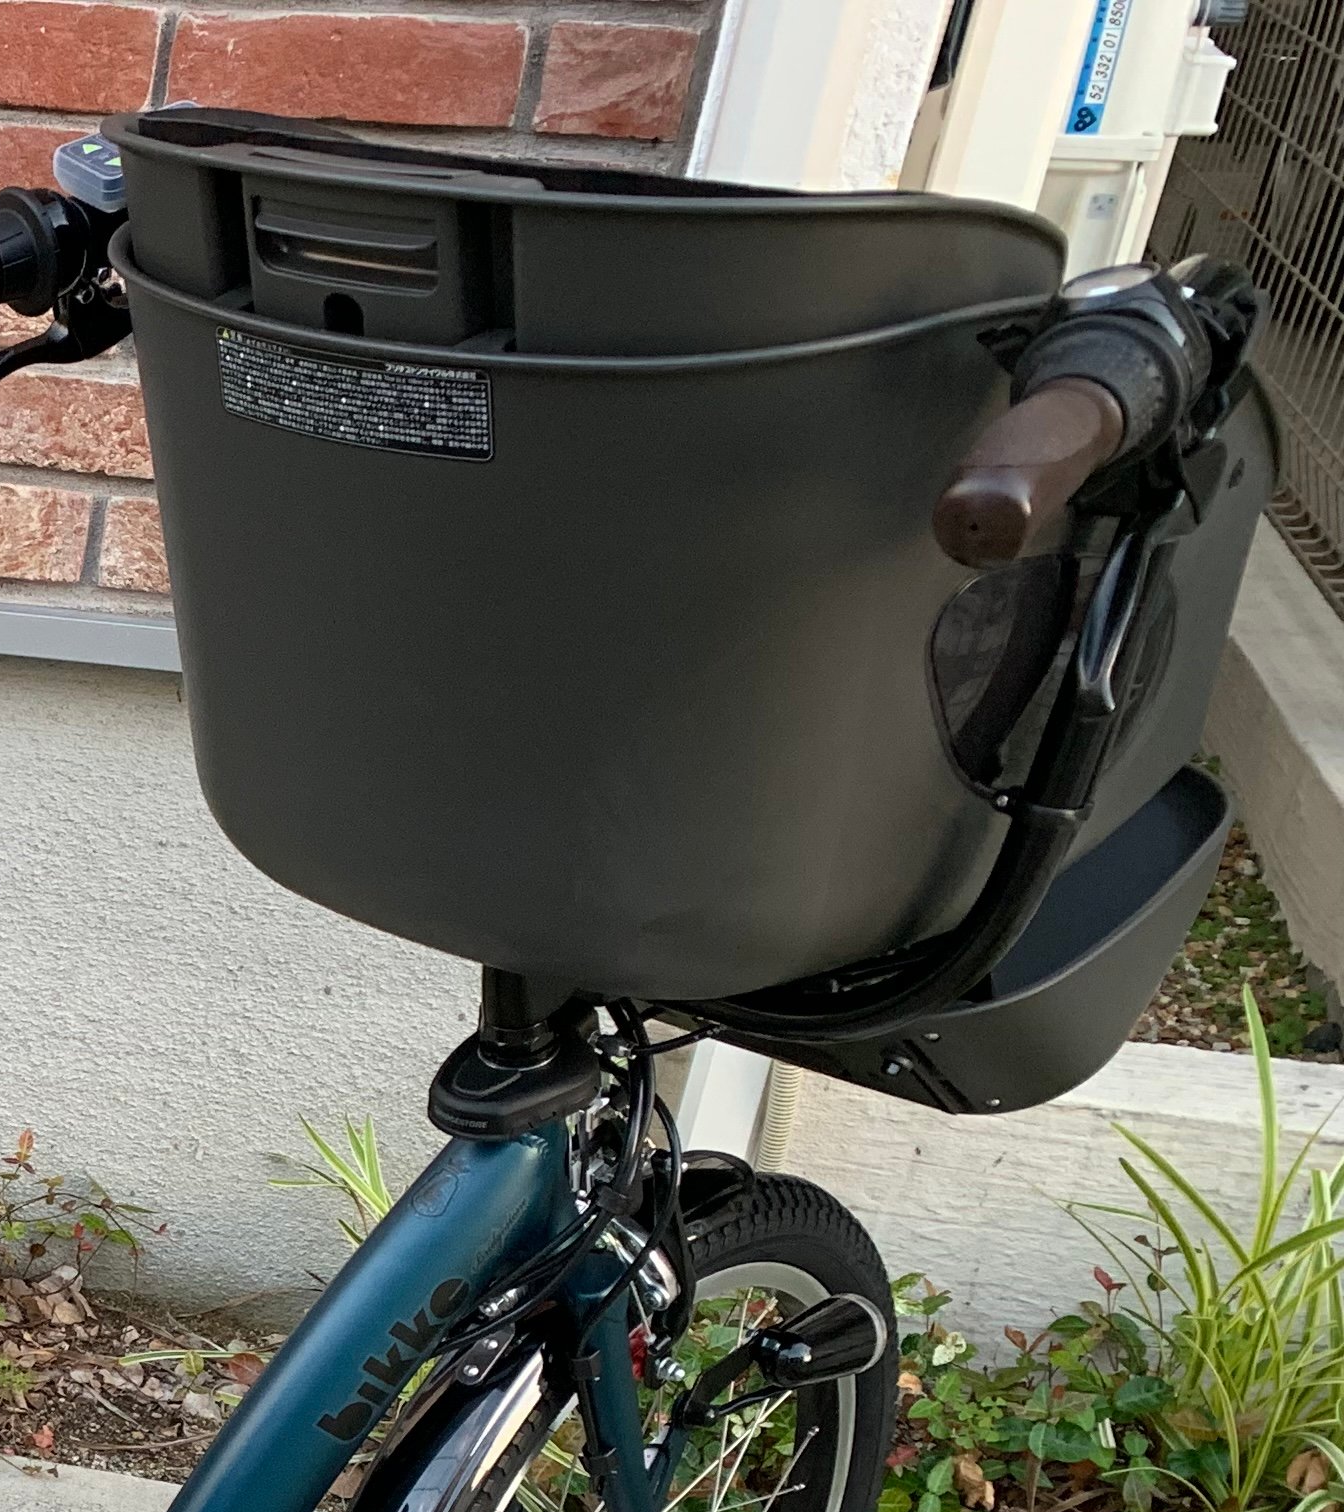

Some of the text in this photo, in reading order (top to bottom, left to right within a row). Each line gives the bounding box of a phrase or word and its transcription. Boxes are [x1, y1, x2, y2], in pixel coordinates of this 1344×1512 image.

[1103, 32, 1119, 49] 01
[1095, 54, 1113, 79] 332
[1089, 84, 1105, 101] 52
